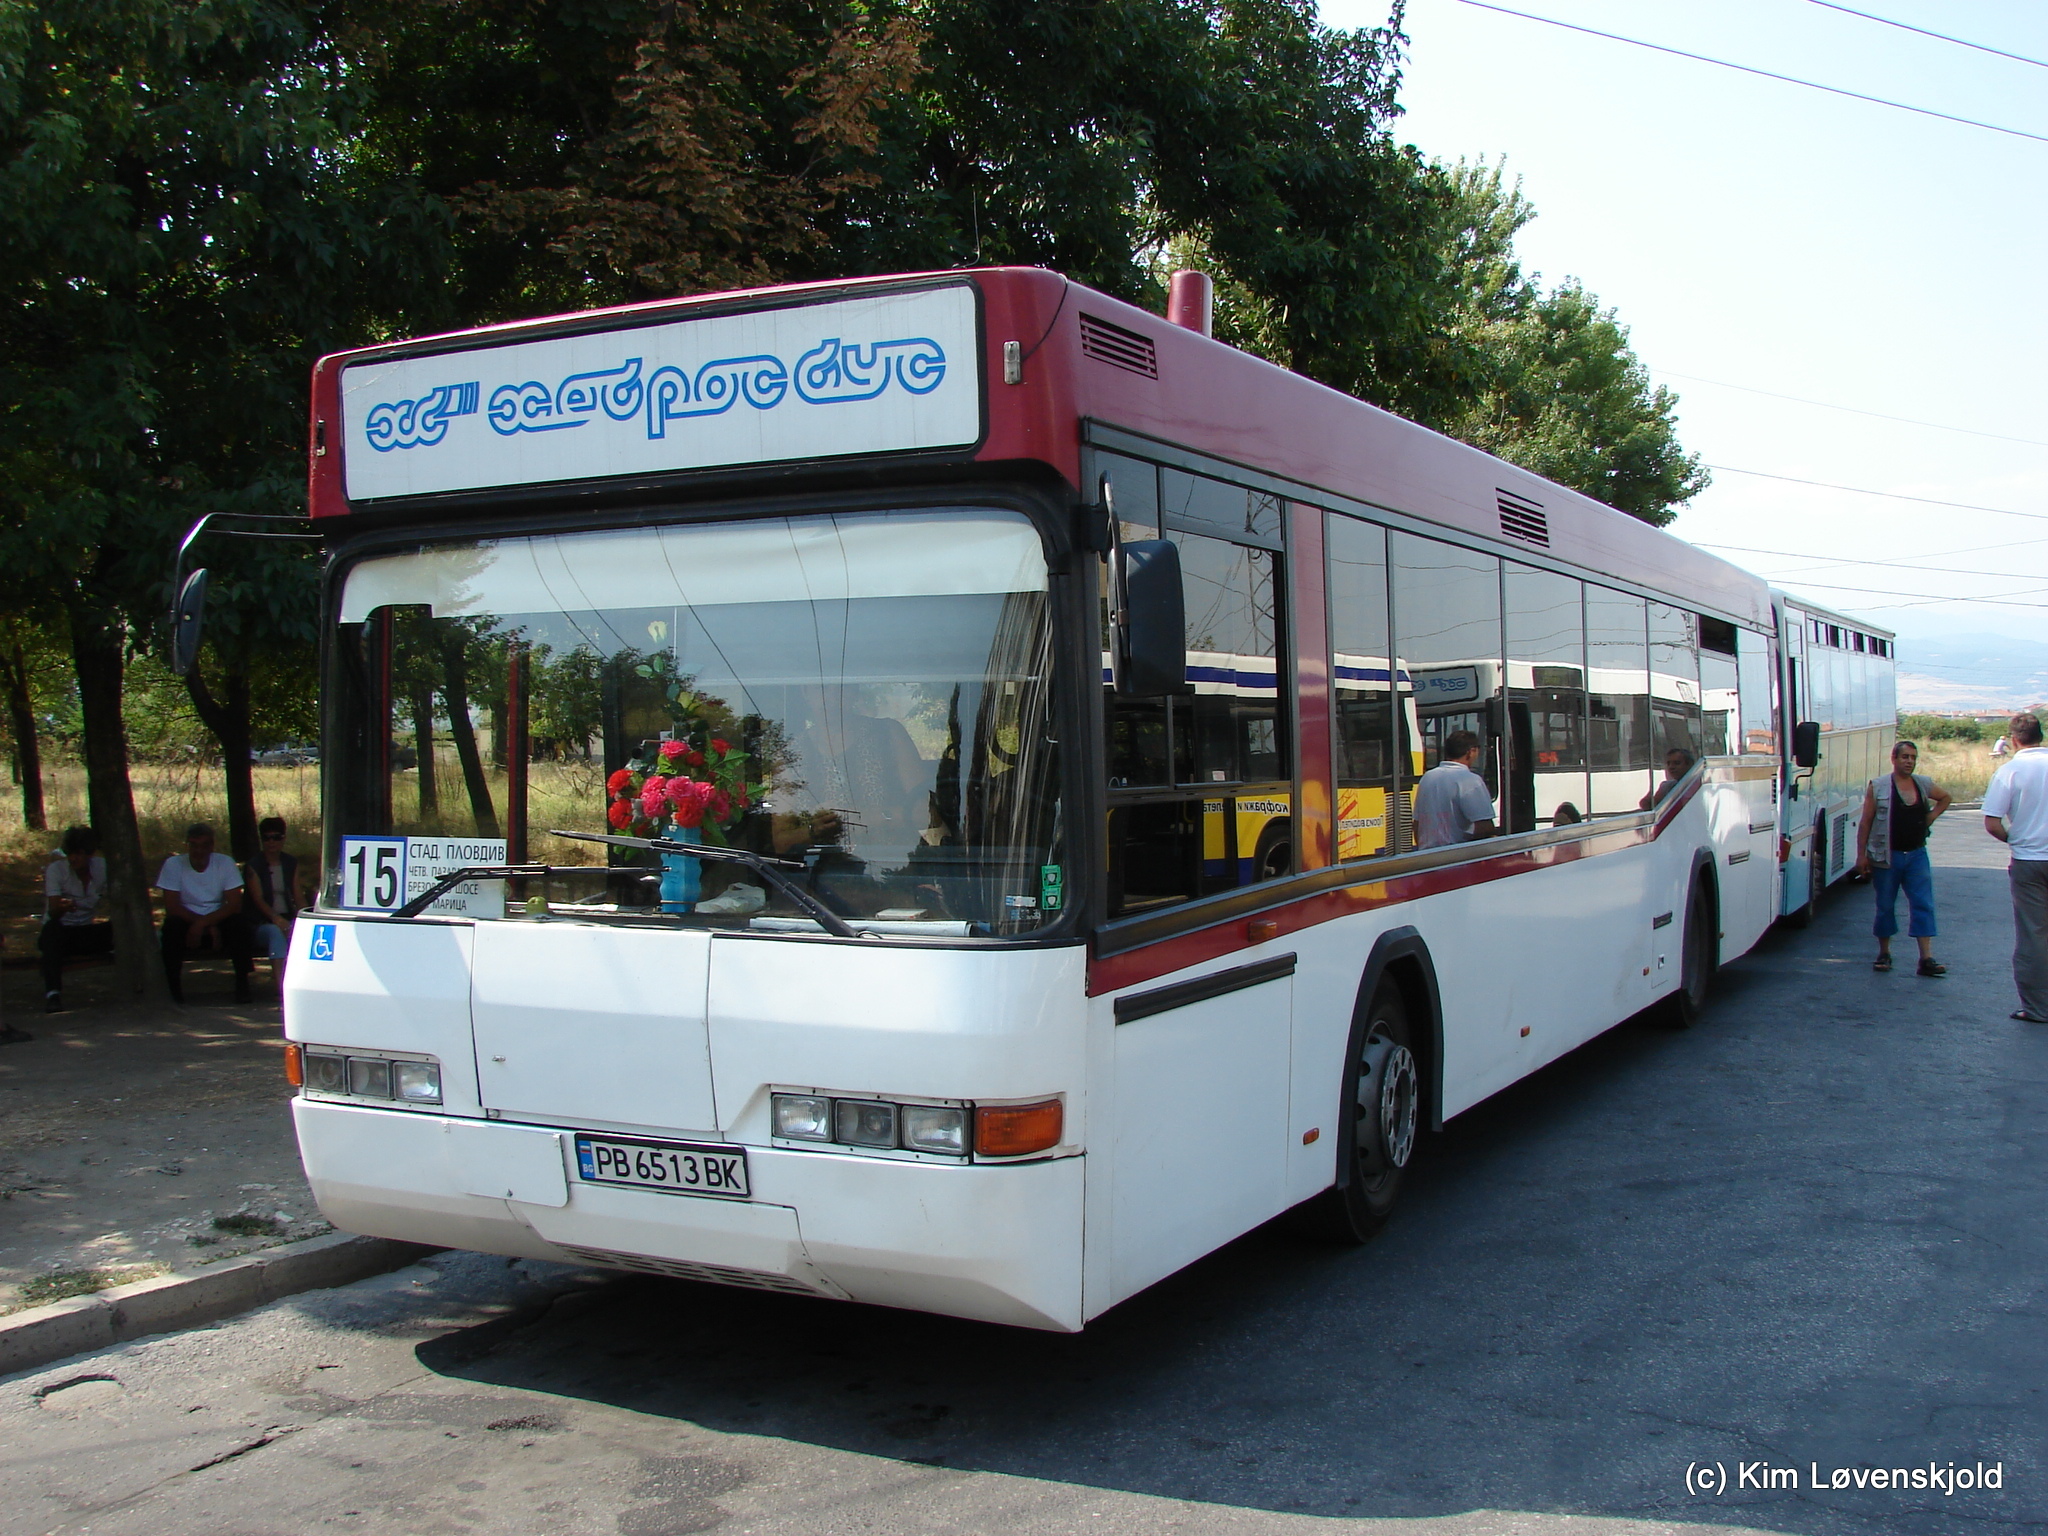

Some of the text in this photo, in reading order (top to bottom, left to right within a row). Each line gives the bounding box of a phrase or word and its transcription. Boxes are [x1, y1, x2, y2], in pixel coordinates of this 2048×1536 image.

[409, 844, 505, 864] СТАД. ПЛОВДИВ
[350, 846, 398, 907] 15
[455, 883, 478, 895] ШОСЕ
[432, 898, 467, 911] МАРИЦА
